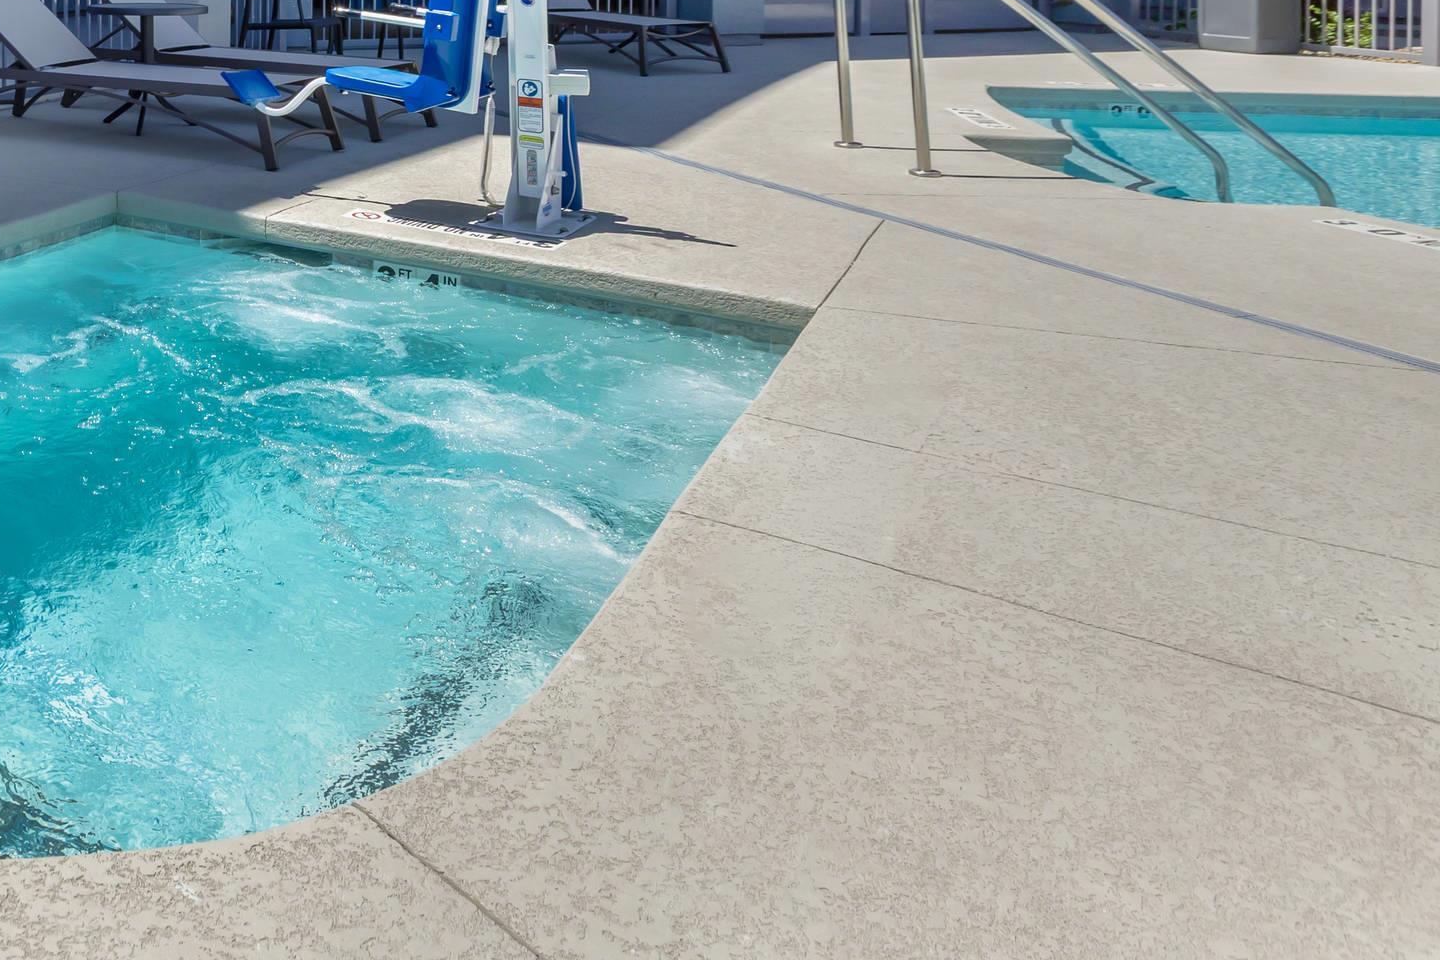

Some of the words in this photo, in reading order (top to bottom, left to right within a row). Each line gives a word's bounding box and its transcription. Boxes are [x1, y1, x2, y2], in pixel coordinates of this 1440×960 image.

[444, 226, 466, 236] NO
[398, 268, 413, 280] FT
[443, 275, 458, 287] IN
